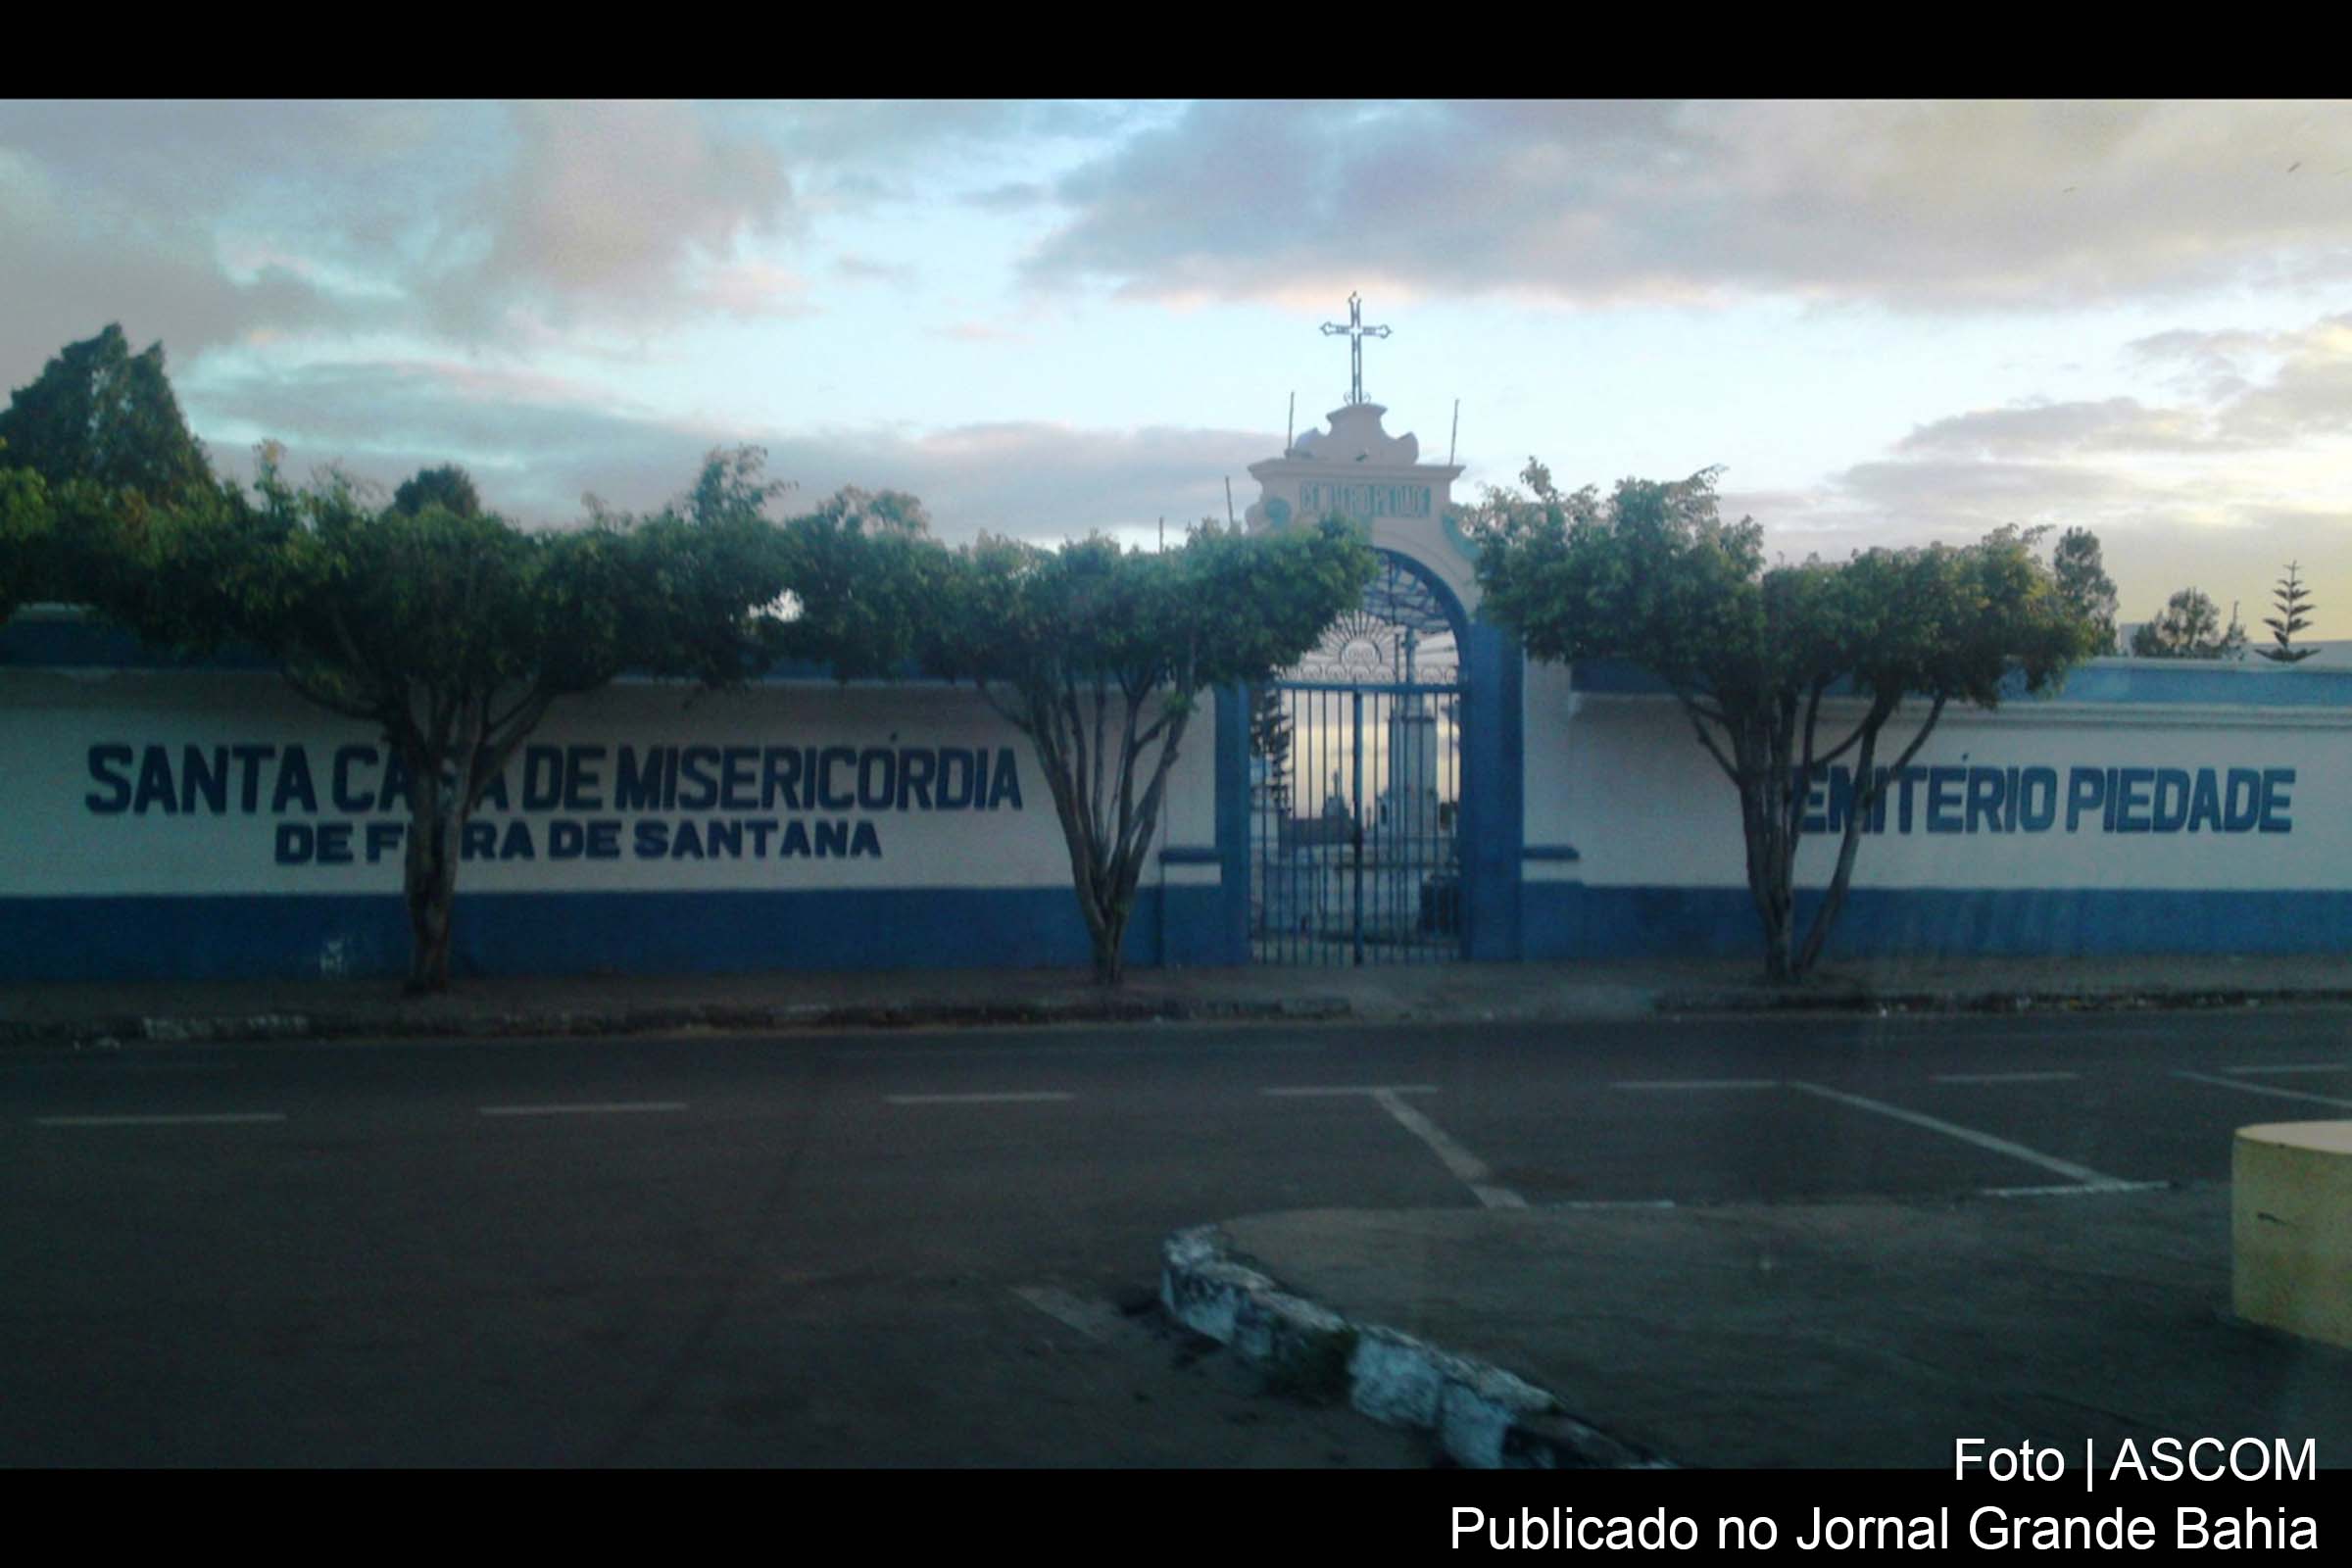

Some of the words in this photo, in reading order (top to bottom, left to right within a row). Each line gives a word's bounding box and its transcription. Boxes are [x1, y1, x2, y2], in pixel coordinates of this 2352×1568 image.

[84, 743, 318, 815] SANTA
[330, 743, 510, 813] CAA
[521, 745, 607, 812] DE
[613, 732, 1024, 812] MISERICÓRDIA
[1761, 754, 2057, 834] EMITÉRIO
[2065, 766, 2297, 834] PIEDADE
[274, 821, 354, 864] DE
[366, 820, 536, 863] FRA
[548, 820, 622, 859] DE
[633, 819, 883, 859] SANTANA
